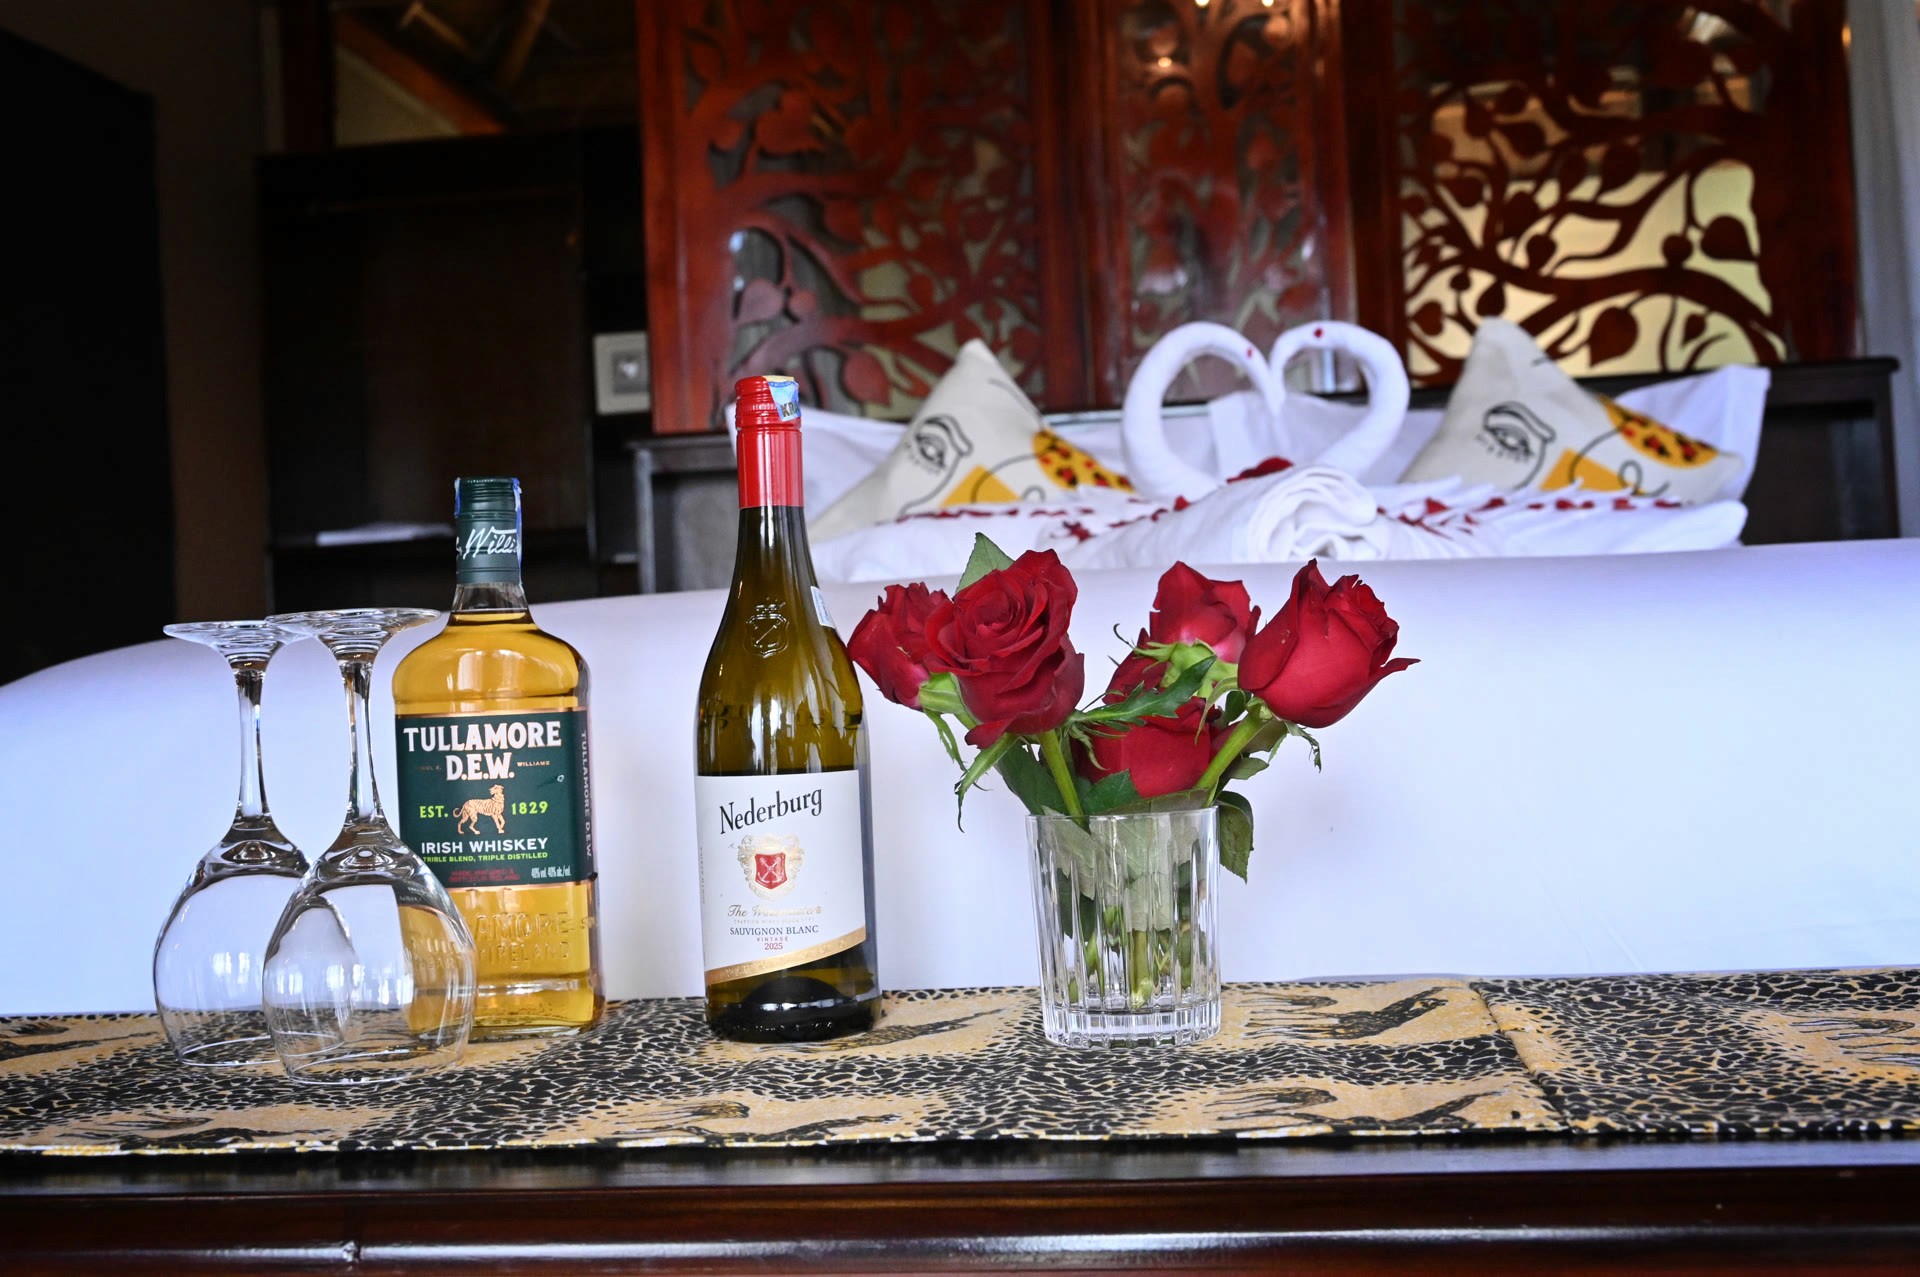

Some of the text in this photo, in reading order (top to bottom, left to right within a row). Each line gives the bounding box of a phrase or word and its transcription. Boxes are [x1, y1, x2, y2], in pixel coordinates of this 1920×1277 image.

[462, 526, 518, 560] Willi
[403, 720, 562, 752] TULLAMORE
[445, 752, 515, 781] D.E.W.
[516, 760, 550, 768] WILLIAMS
[581, 730, 590, 817] TULLAMORE
[419, 805, 449, 819] EST.
[511, 801, 548, 816] 1829
[720, 788, 822, 835] Nederburg
[421, 837, 548, 864] IRISH WHISKEY
[449, 855, 476, 863] BLEND,
[478, 853, 505, 862] TRIPLE
[507, 851, 549, 860] DISTILLED
[727, 904, 748, 918] The
[729, 925, 819, 936] SAUVIGNON BLANC
[764, 943, 784, 951] 2025
